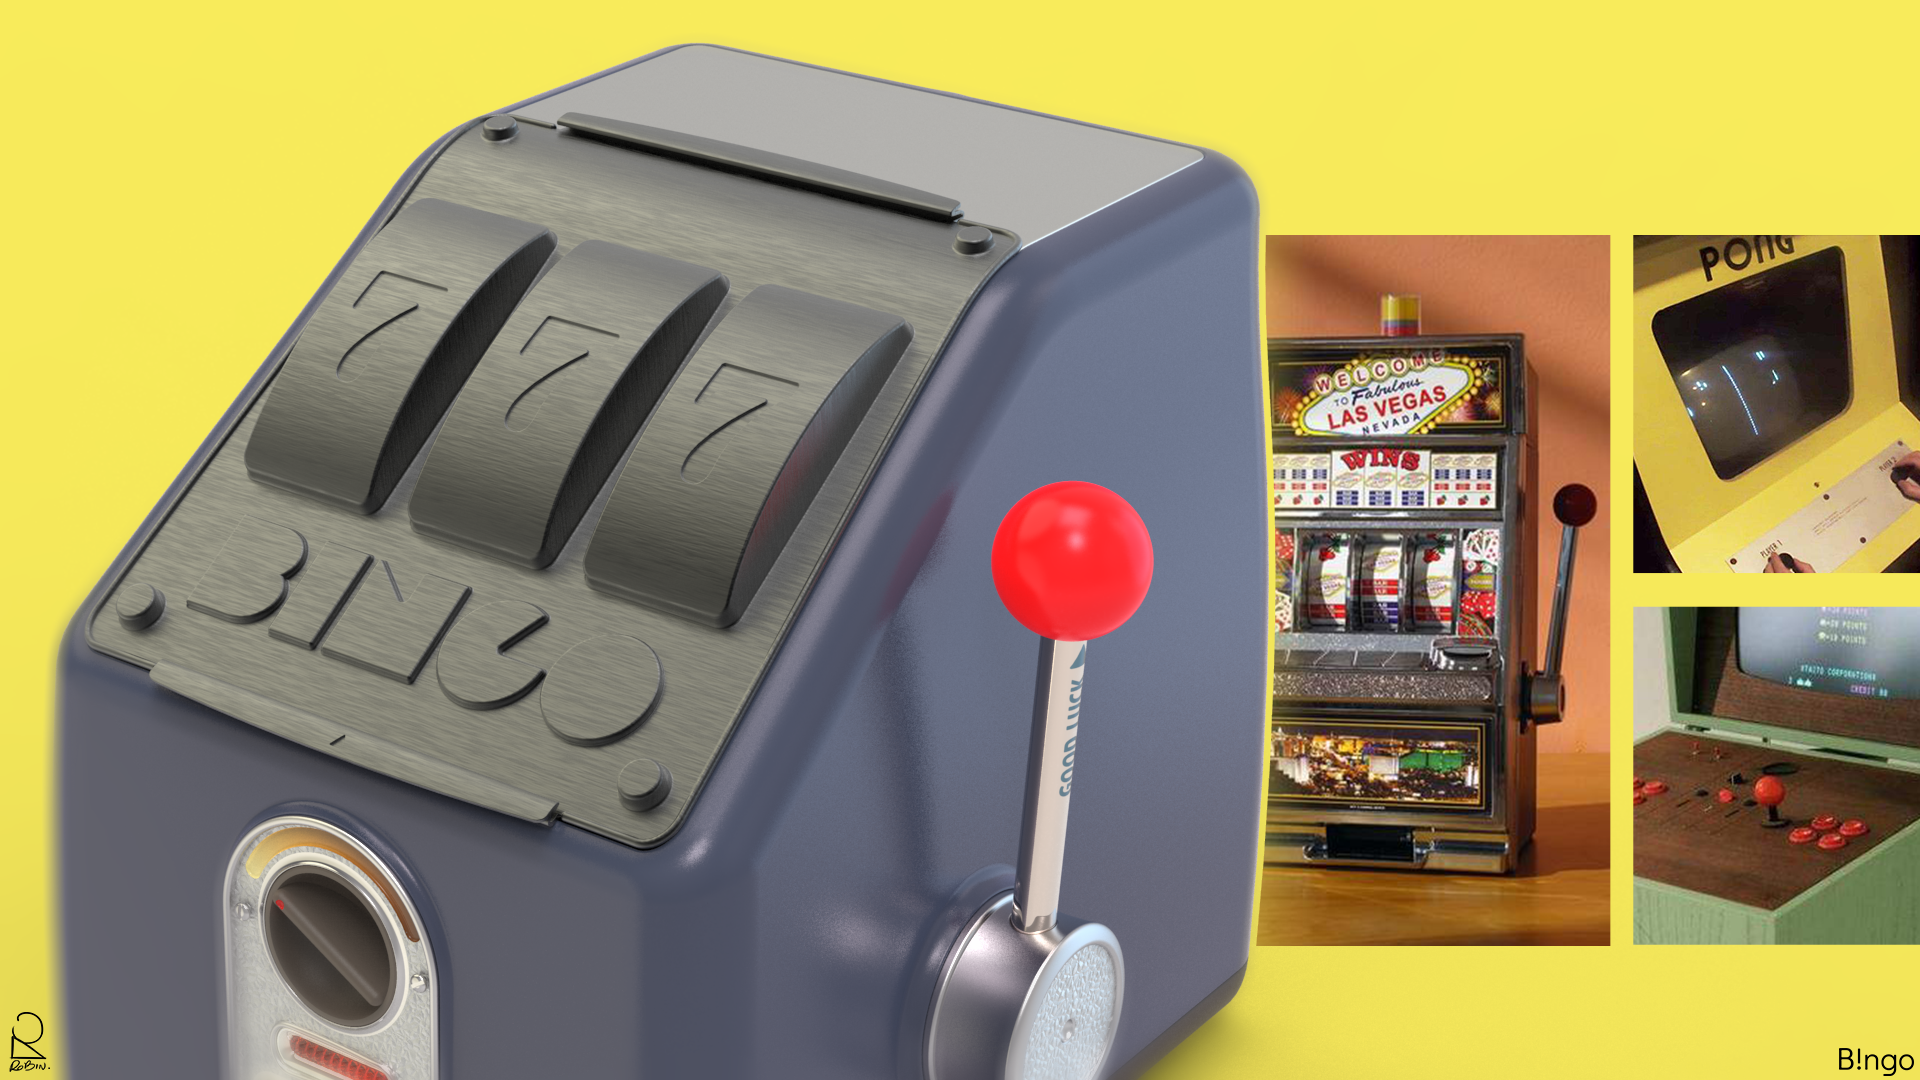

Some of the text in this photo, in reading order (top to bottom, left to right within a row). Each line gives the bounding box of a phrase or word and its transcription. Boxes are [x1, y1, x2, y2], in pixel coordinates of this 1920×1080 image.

[336, 270, 800, 484] 7 7 7
[1316, 350, 1443, 393] WELCOME
[1334, 378, 1424, 407] TO Fabulous
[1327, 385, 1447, 431] LAS VEGAS
[1362, 412, 1422, 436] NEVADA
[1341, 448, 1421, 471] WINS
[1760, 543, 1778, 558] PLAYER
[187, 515, 665, 748] BINGO
[1059, 678, 1083, 797] GOOD LUCK
